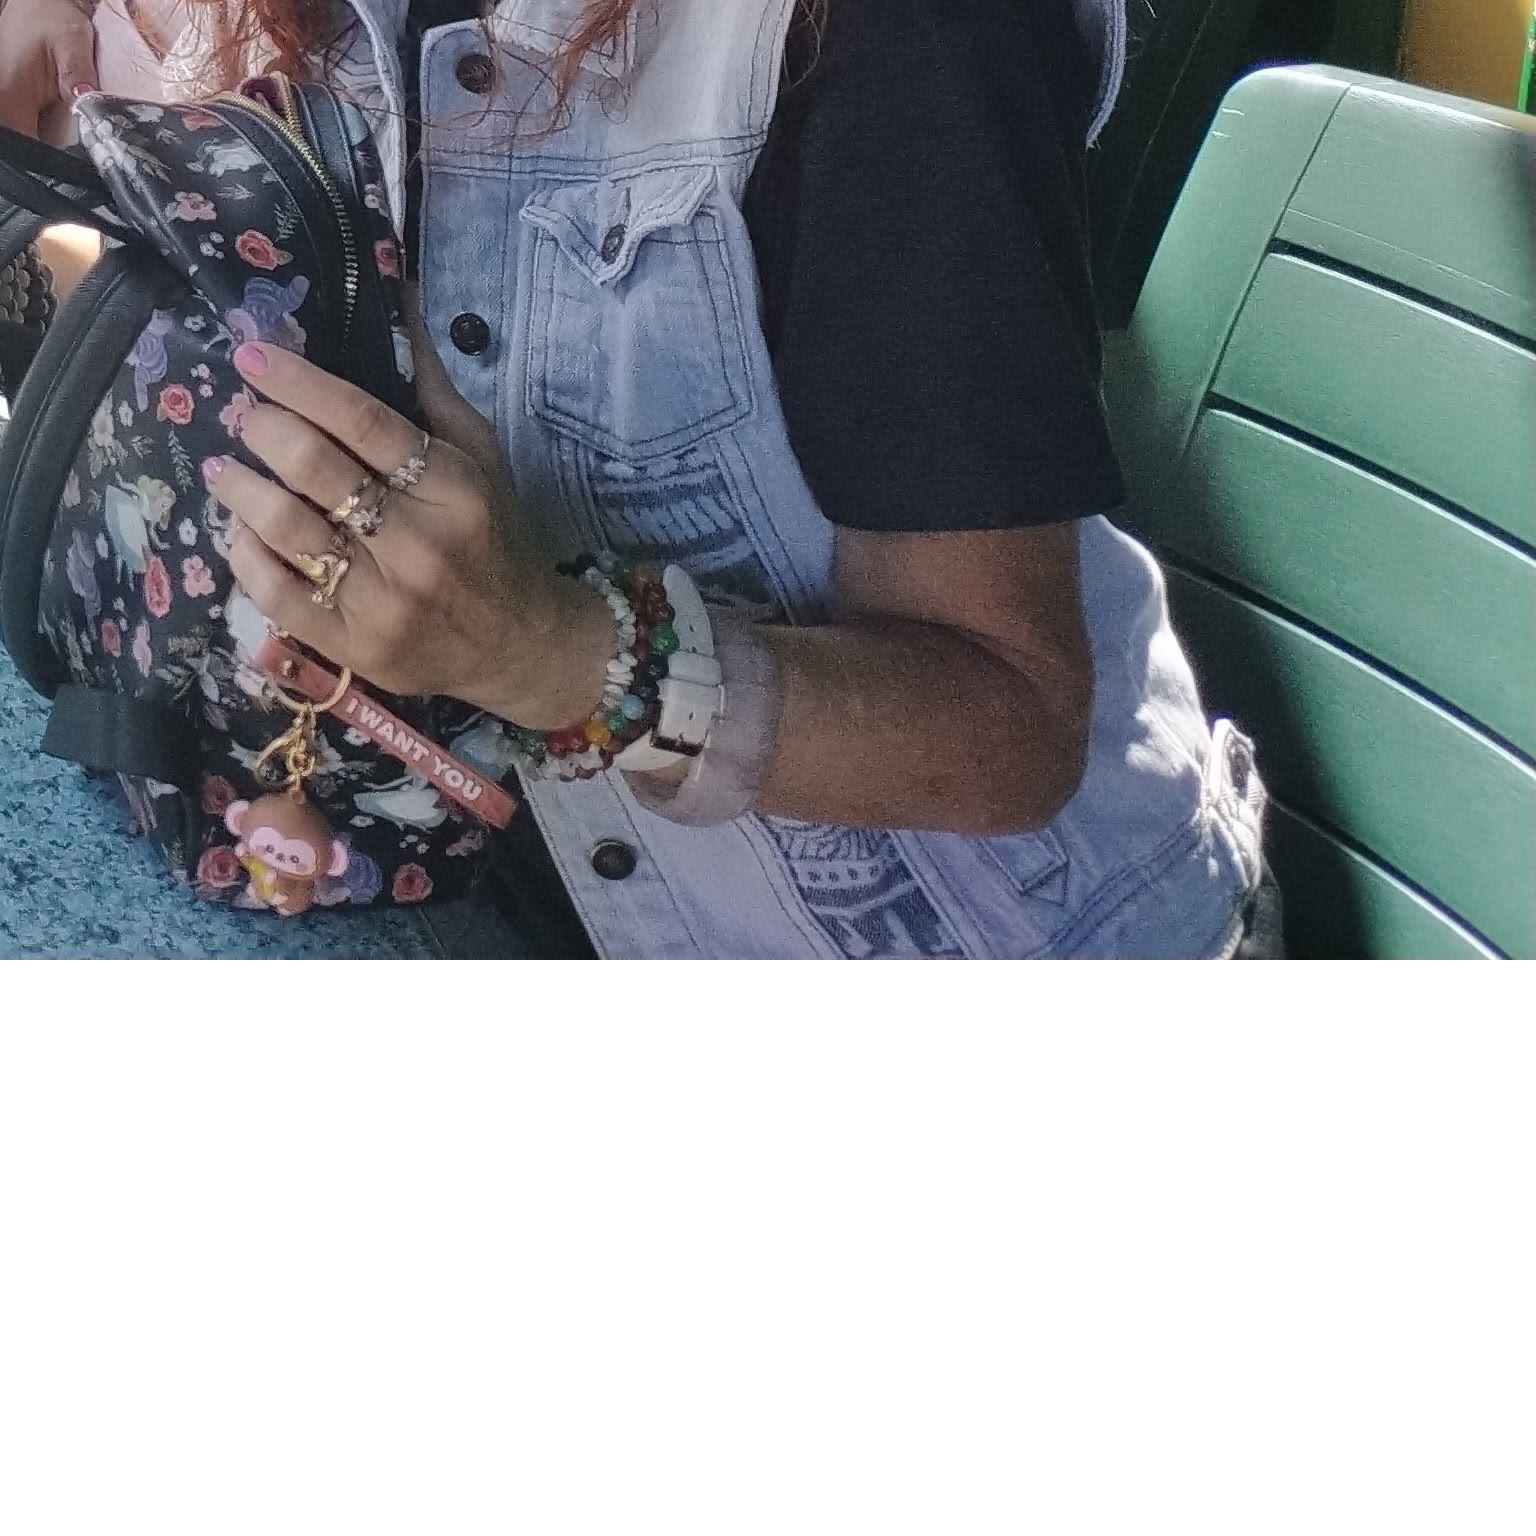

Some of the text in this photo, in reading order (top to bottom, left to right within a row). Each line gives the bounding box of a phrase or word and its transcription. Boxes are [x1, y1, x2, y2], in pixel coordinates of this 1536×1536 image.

[345, 697, 483, 801] I WANT YOU
